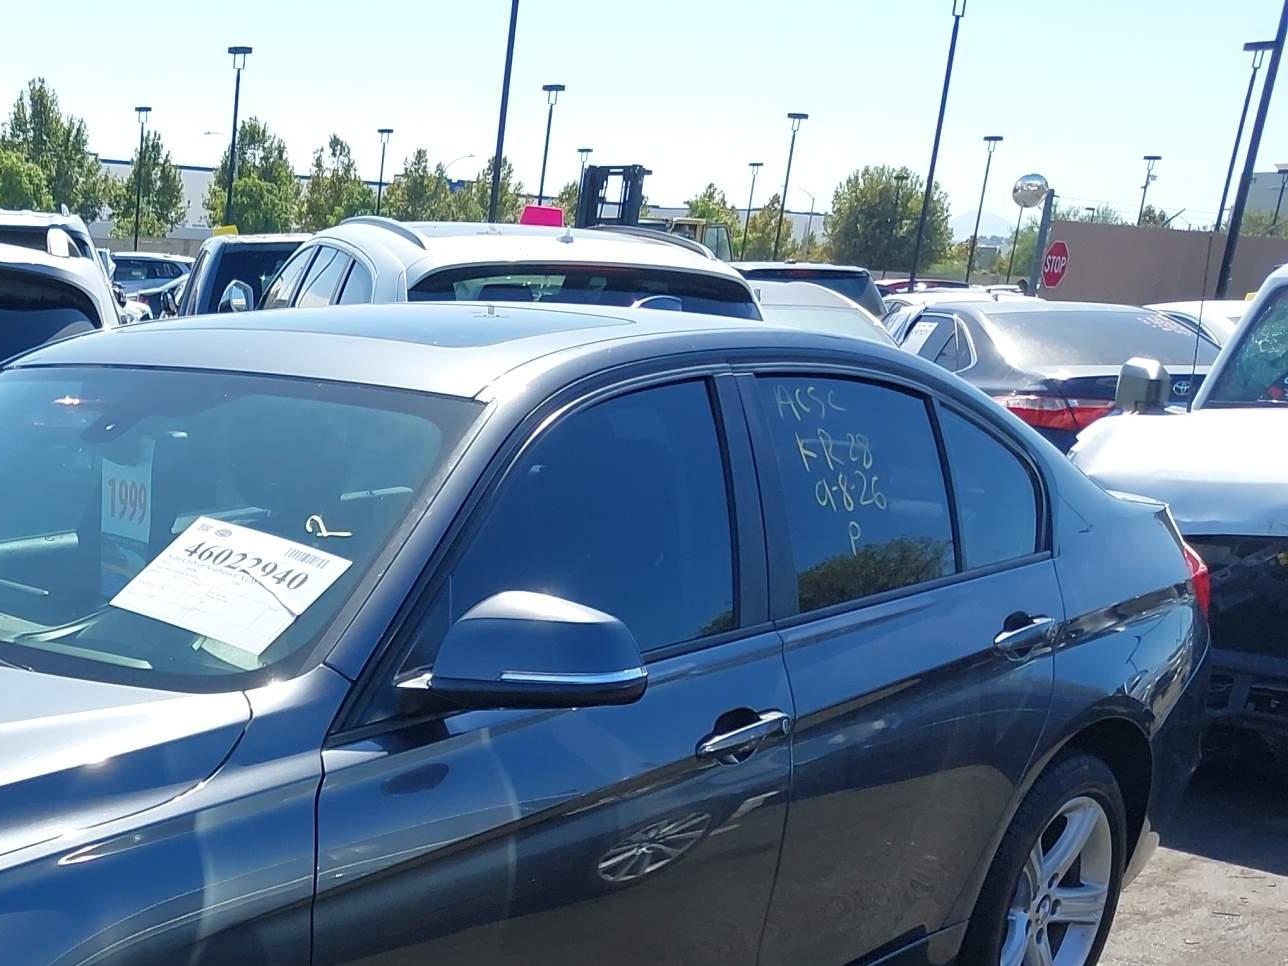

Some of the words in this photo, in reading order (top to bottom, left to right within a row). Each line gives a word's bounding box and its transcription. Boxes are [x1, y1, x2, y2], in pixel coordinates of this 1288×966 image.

[1044, 255, 1067, 273] STOP
[108, 478, 147, 524] 1999
[848, 520, 862, 557] P
[184, 541, 309, 590] 46022940
